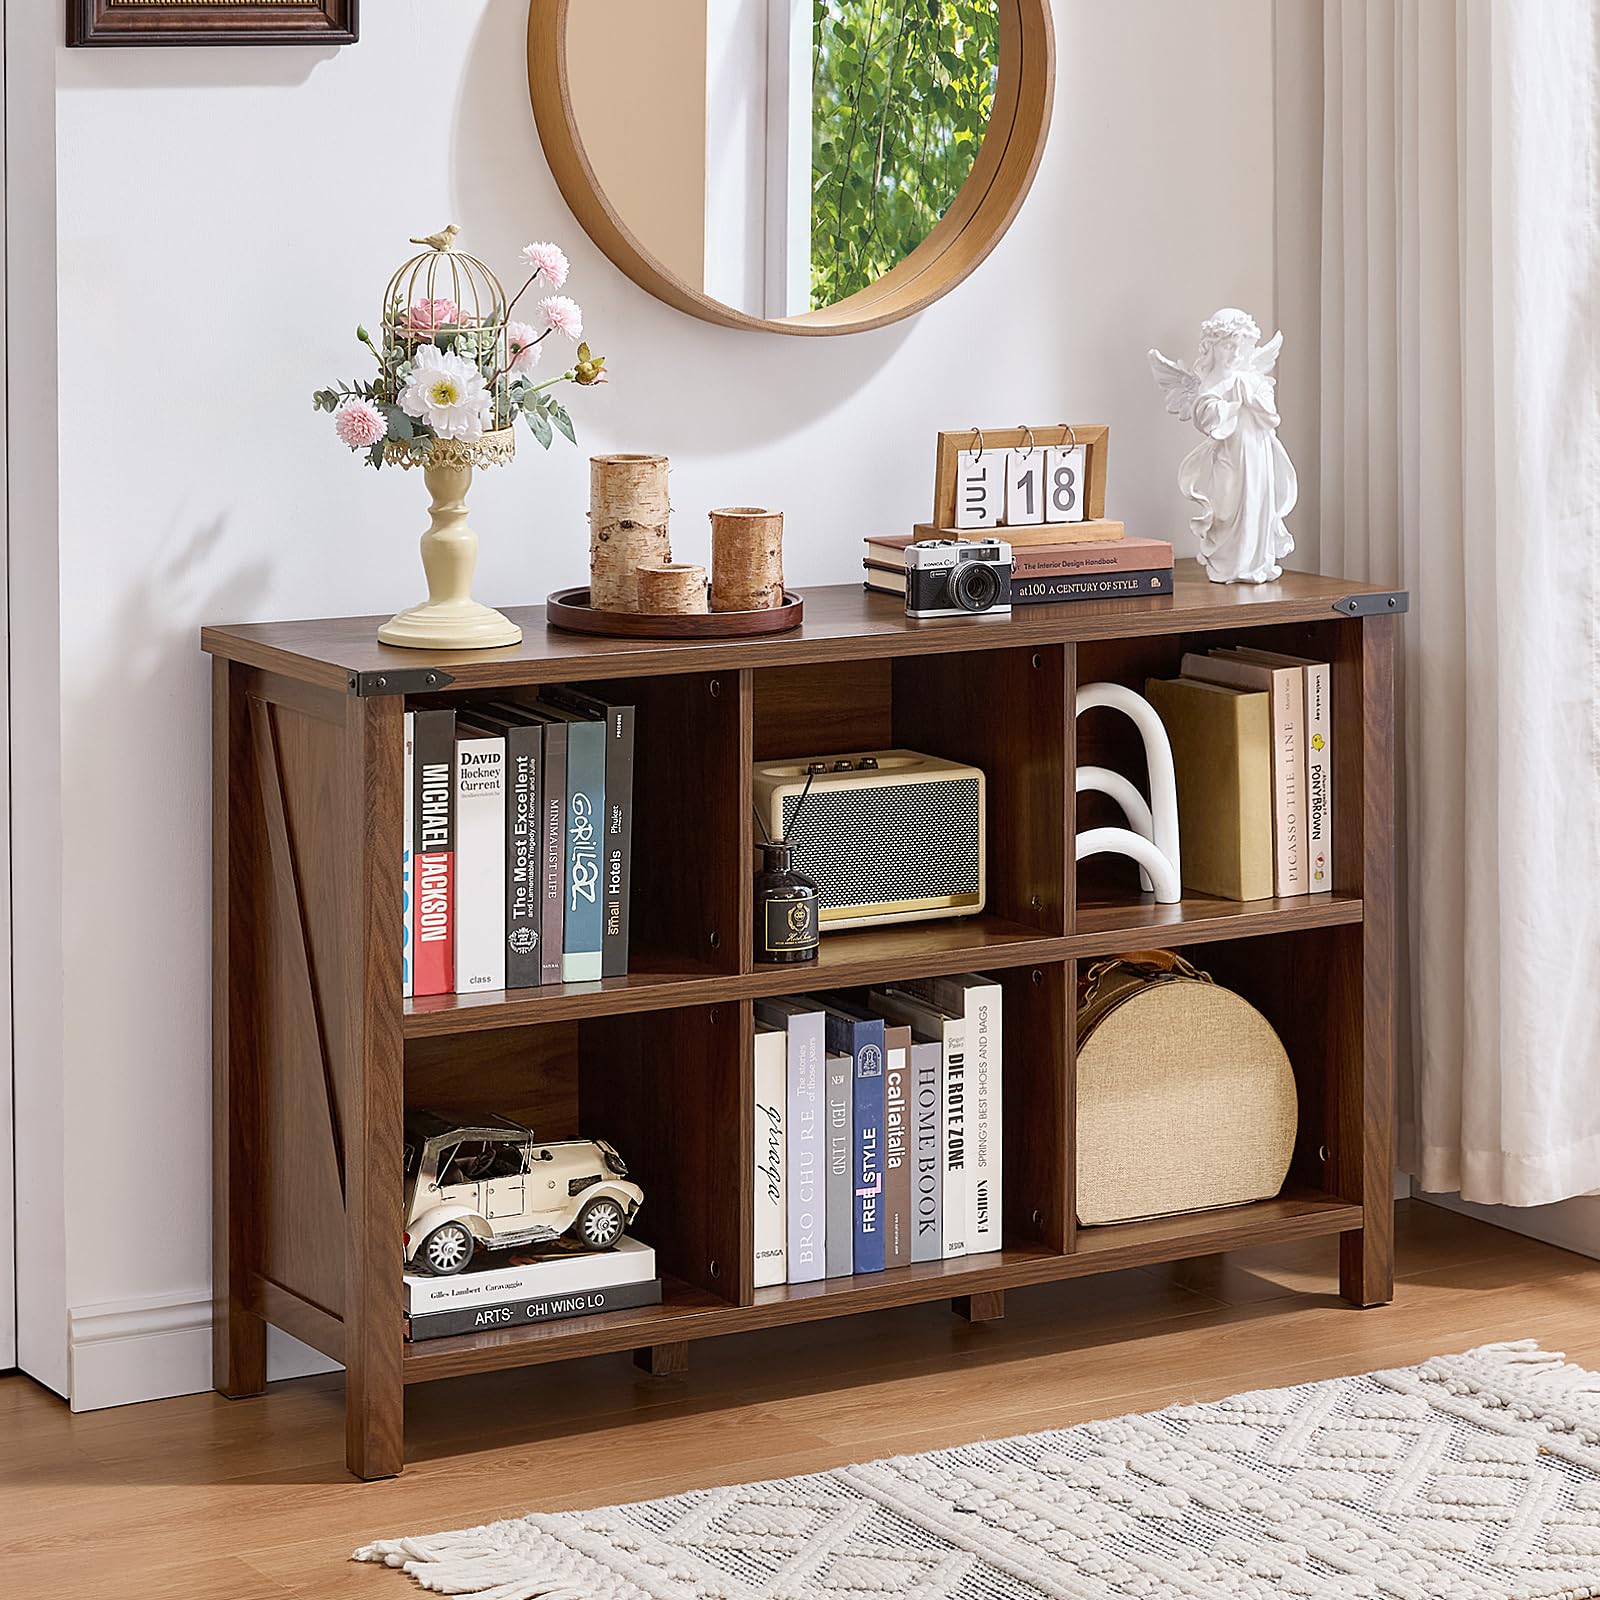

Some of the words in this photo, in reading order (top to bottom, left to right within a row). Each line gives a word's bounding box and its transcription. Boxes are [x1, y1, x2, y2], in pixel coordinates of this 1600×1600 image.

[966, 467, 986, 519] JUL
[1017, 470, 1034, 514] 1
[1053, 467, 1076, 512] 8
[1037, 561, 1061, 570] Interior
[1062, 560, 1084, 569] Design
[1085, 557, 1118, 566] Handbook
[1048, 587, 1055, 595] A
[1056, 582, 1098, 594] CENTURY
[1099, 581, 1112, 591] OF
[1113, 579, 1139, 590] STYLE
[461, 752, 501, 765] DAVID
[1284, 721, 1295, 763] LINE
[460, 780, 501, 791] Current
[461, 767, 501, 779] Hockney
[515, 756, 529, 835] Excellent
[1286, 772, 1296, 808] THE
[1311, 764, 1323, 840] PONYBROWN
[421, 763, 449, 852] MICHAEL
[528, 819, 535, 828] of
[610, 805, 619, 834] Phuket
[528, 828, 536, 859] Tragedy
[548, 799, 560, 870] MINIMALIST
[1287, 812, 1298, 882] PICASSO
[514, 839, 528, 883] Most
[609, 850, 621, 894] Hotels
[420, 853, 448, 942] JACKSON
[548, 872, 558, 899] LIFE
[513, 887, 527, 920] The
[608, 901, 620, 935] small
[469, 975, 491, 984] class
[979, 1005, 989, 1033] BAGS
[798, 1044, 806, 1075] stories
[808, 1037, 817, 1063] years
[979, 1036, 988, 1060] AND
[807, 1064, 816, 1089] those
[948, 1053, 964, 1080] DIE
[978, 1062, 988, 1096] SHOES
[797, 1078, 806, 1097] The
[806, 1090, 815, 1102] of
[948, 1082, 964, 1125] ROTE
[801, 1109, 814, 1141] RE
[831, 1100, 846, 1128] JED
[887, 1072, 906, 1169] caliaitalia
[918, 1067, 936, 1151] HOME
[978, 1098, 988, 1121] BEST
[832, 1137, 846, 1175] LIND
[863, 1127, 877, 1183] STYLE
[948, 1128, 964, 1172] ZONE
[978, 1123, 988, 1168] SPRING'S
[800, 1151, 814, 1203] CHU
[918, 1158, 936, 1236] BOOK
[977, 1179, 989, 1234] FASHION
[800, 1212, 814, 1265] BRO
[948, 1242, 965, 1251] DESIGN
[430, 1291, 450, 1299] Gilles
[451, 1286, 481, 1297] Lambert
[485, 1280, 523, 1292] Caravaggio
[526, 1304, 549, 1318] CHI
[550, 1297, 585, 1313] WING
[587, 1294, 605, 1307] LO
